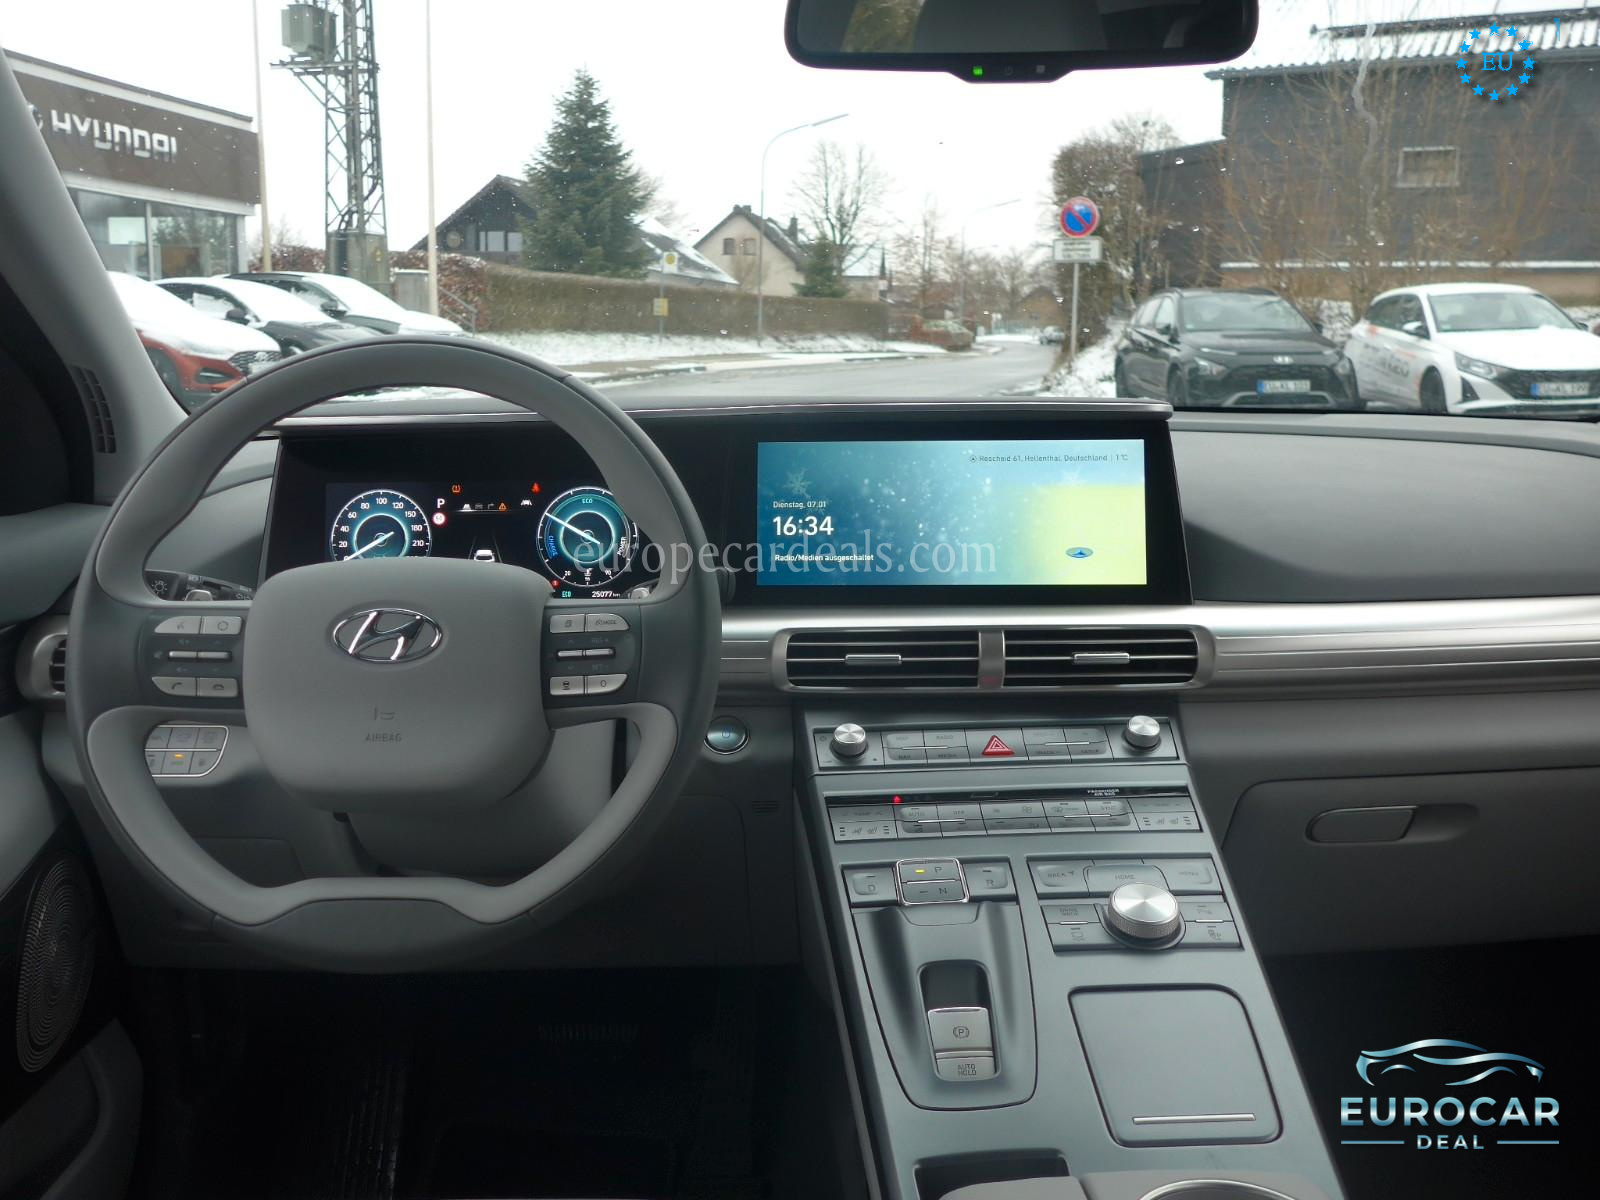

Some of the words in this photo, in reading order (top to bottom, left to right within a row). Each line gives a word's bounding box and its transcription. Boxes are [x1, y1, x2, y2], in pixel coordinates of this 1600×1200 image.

[51, 109, 177, 158] HYUNDAI
[437, 498, 445, 509] P
[348, 511, 357, 519] 60
[340, 525, 349, 533] 40
[772, 516, 835, 536] 16:34
[824, 554, 874, 563] ausgeschaltet
[591, 590, 613, 598] 25077
[986, 879, 994, 887] R
[868, 884, 876, 892] D
[939, 887, 948, 895] N
